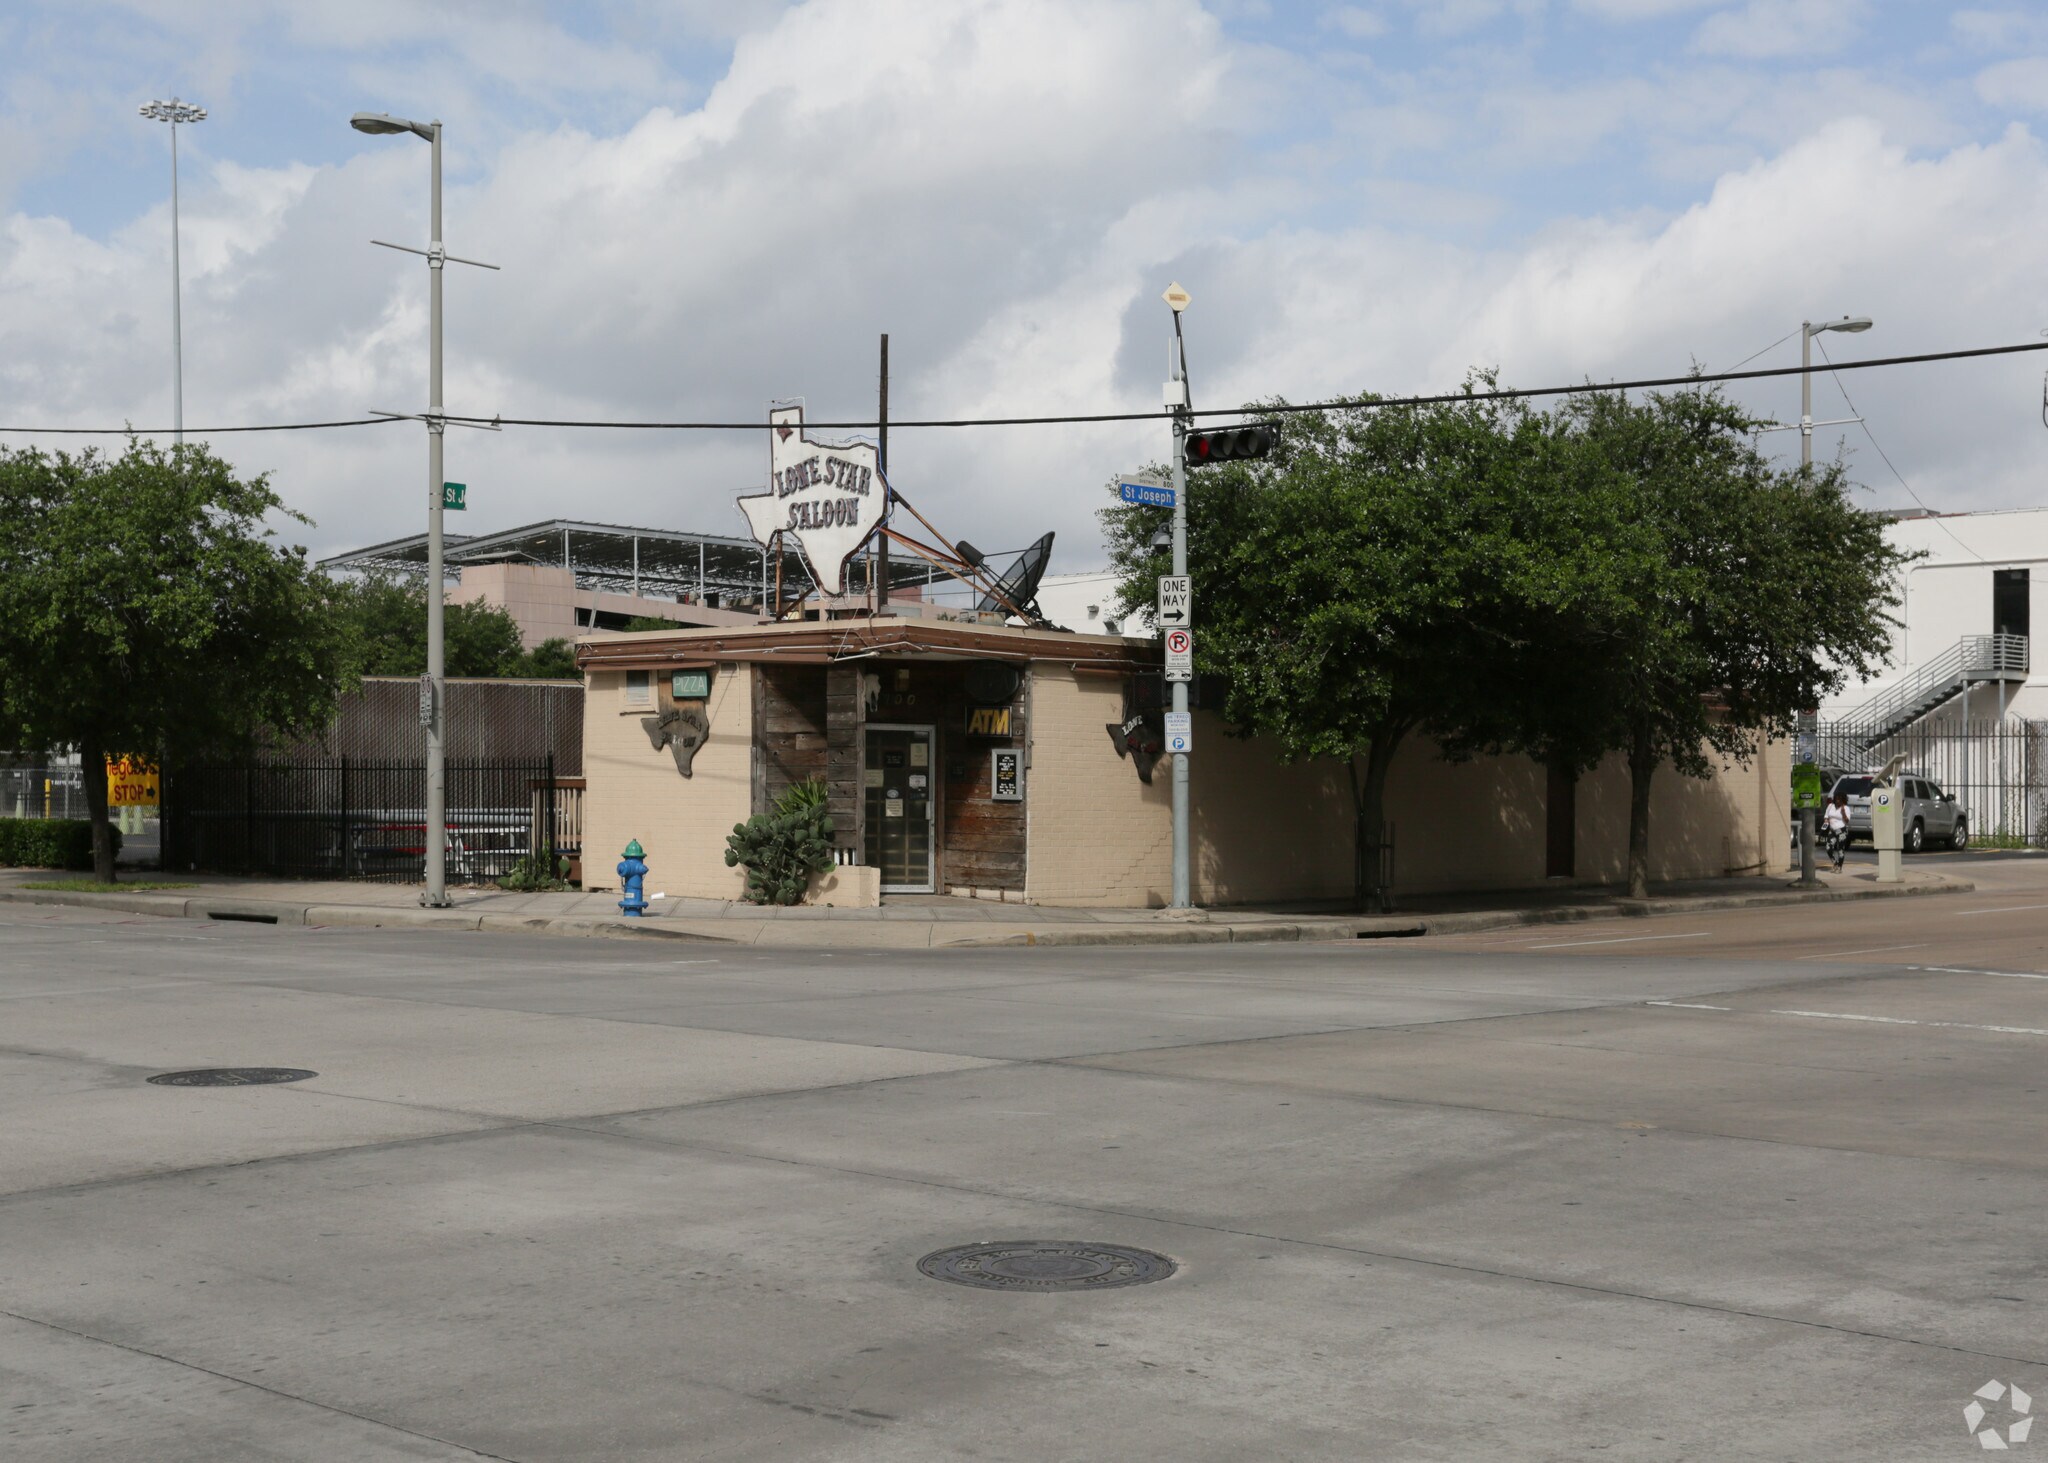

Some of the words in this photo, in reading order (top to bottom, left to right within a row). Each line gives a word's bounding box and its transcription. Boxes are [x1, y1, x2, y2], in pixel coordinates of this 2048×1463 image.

[775, 455, 822, 499] LONE
[823, 455, 872, 497] STAR
[446, 487, 456, 502] St
[458, 489, 466, 503] J
[1125, 486, 1135, 499] St
[1138, 488, 1172, 505] Joseph
[787, 498, 860, 531] SALOON
[1163, 580, 1187, 592] ONE
[1163, 594, 1187, 606] WAY
[673, 675, 706, 692] PIZZA
[968, 708, 1010, 735] ATM
[114, 785, 144, 801] STOP
